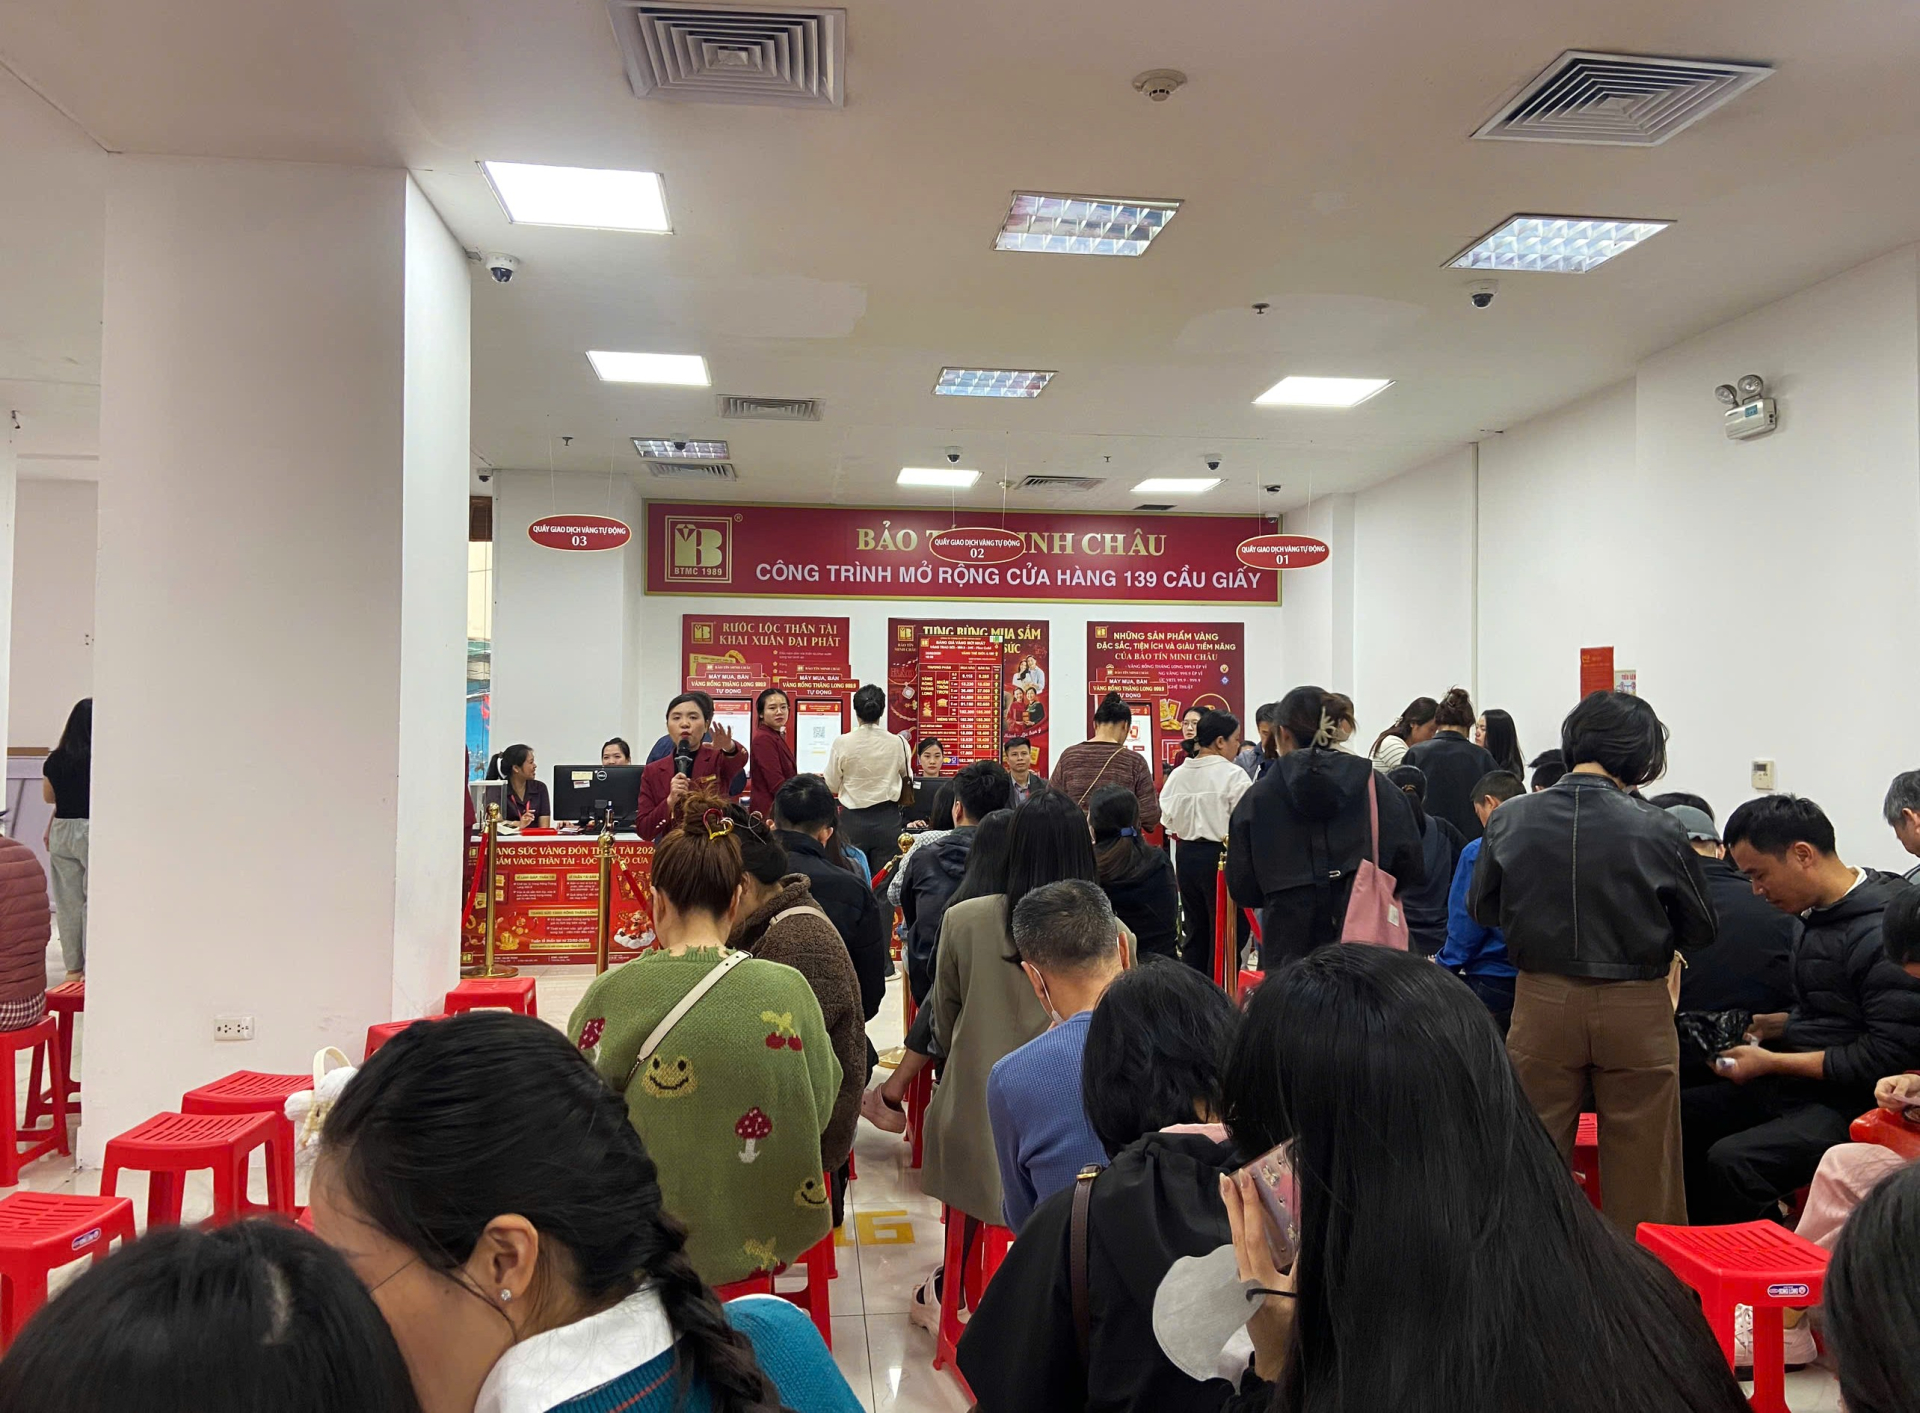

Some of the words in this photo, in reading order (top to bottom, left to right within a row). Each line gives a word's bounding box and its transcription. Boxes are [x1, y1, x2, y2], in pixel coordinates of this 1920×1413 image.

[566, 526, 580, 534] DỊCH
[581, 525, 598, 534] VÀNG
[598, 526, 607, 535] TỰ
[608, 526, 626, 535] ĐỘNG
[572, 535, 587, 546] 03
[856, 520, 918, 551] BẢO
[1081, 528, 1166, 556] CHÂU
[965, 539, 978, 547] DỊCH
[979, 538, 995, 546] VÀNG
[995, 539, 1003, 548] TỰ
[1003, 539, 1020, 548] ĐỘNG
[970, 548, 984, 558] 02
[1271, 546, 1284, 554] DỊCH
[1285, 545, 1300, 553] VÀNG
[1300, 545, 1308, 553] TỰ
[1309, 545, 1325, 553] ĐỘNG
[1276, 555, 1289, 564] 01
[675, 567, 698, 575] BTMC
[756, 560, 819, 581] CÔNG
[826, 561, 891, 582] TRÌNH
[899, 561, 932, 583] MỞ
[938, 563, 999, 587] RỘNG
[1006, 562, 1050, 585] CỬA
[1057, 565, 1116, 587] HÀNG
[1124, 570, 1157, 587] 139
[1163, 565, 1205, 588] CẦU
[1212, 566, 1261, 589] GIẤY
[723, 622, 754, 633] RƯỚC
[759, 622, 780, 634] LỘC
[819, 623, 837, 634] TÀI
[1017, 624, 1041, 640] SẮM
[1114, 631, 1145, 640] NHỮNG
[1147, 630, 1164, 640] SẢN
[1167, 630, 1191, 640] PHẨM
[1194, 631, 1219, 641] VÀNG
[719, 635, 747, 645] KHAI
[752, 635, 783, 646] XUÂN
[788, 636, 807, 647] ĐẠI
[811, 635, 841, 647] PHÁT
[1096, 642, 1113, 650] ĐẶC
[1134, 642, 1149, 651] TIỆN
[1176, 642, 1195, 650] GIÀU
[1214, 642, 1236, 650] NĂNG
[1114, 651, 1132, 660] CỦA
[1134, 652, 1152, 660] BẢO
[1154, 651, 1168, 660] TÍN
[1194, 652, 1218, 661] CHÂU
[517, 845, 537, 855] SỨC
[539, 845, 566, 856] VÀNG
[568, 845, 589, 855] ĐÓN
[591, 847, 617, 855] THN
[619, 845, 634, 855] TÀI
[513, 856, 536, 865] VÀNG
[539, 856, 560, 865] THẦN
[561, 856, 575, 865] TÀI
[581, 856, 598, 865] LỘC
[632, 856, 648, 864] CỬA
